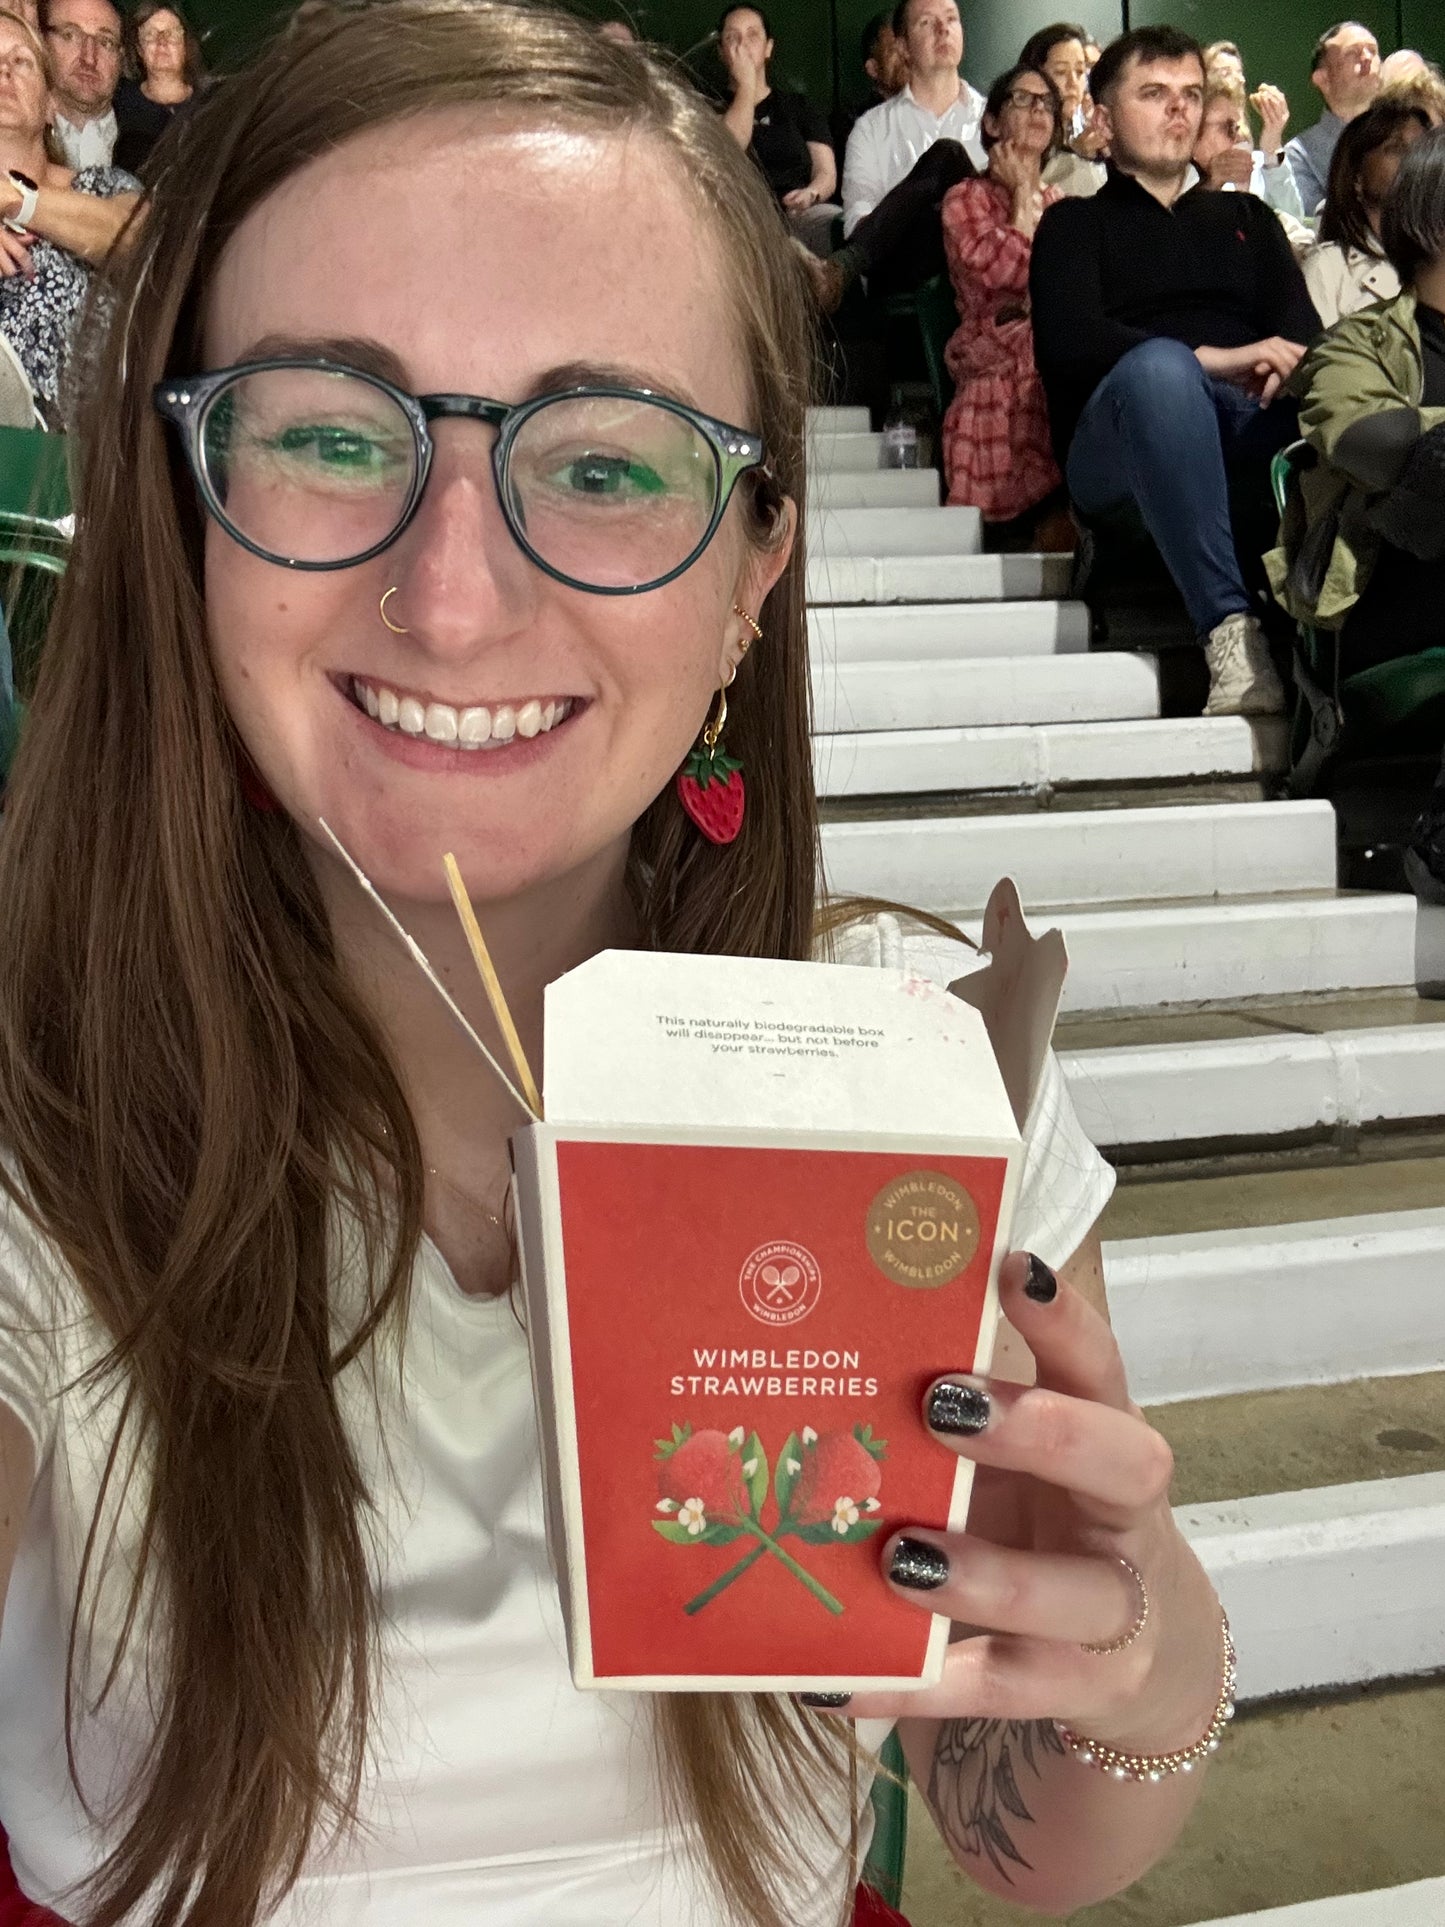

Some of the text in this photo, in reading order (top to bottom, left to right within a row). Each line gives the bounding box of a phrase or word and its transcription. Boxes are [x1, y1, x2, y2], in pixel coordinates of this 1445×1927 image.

[656, 1016, 885, 1037] This naturally biodegradable box
[666, 1028, 690, 1039] will
[778, 1034, 802, 1044] but
[806, 1036, 829, 1045] not
[832, 1037, 879, 1048] before
[711, 1043, 839, 1058] your strawberries.
[883, 1181, 963, 1211] WIMBLEDON
[910, 1206, 937, 1218] THE
[887, 1219, 959, 1242] ICON
[744, 1262, 756, 1280] THE
[884, 1249, 962, 1279] WIMBLEDON
[753, 1303, 806, 1321] WIMBLEDON
[693, 1349, 860, 1369] WIMBLEDON
[670, 1376, 878, 1397] STRAWBERRIES
